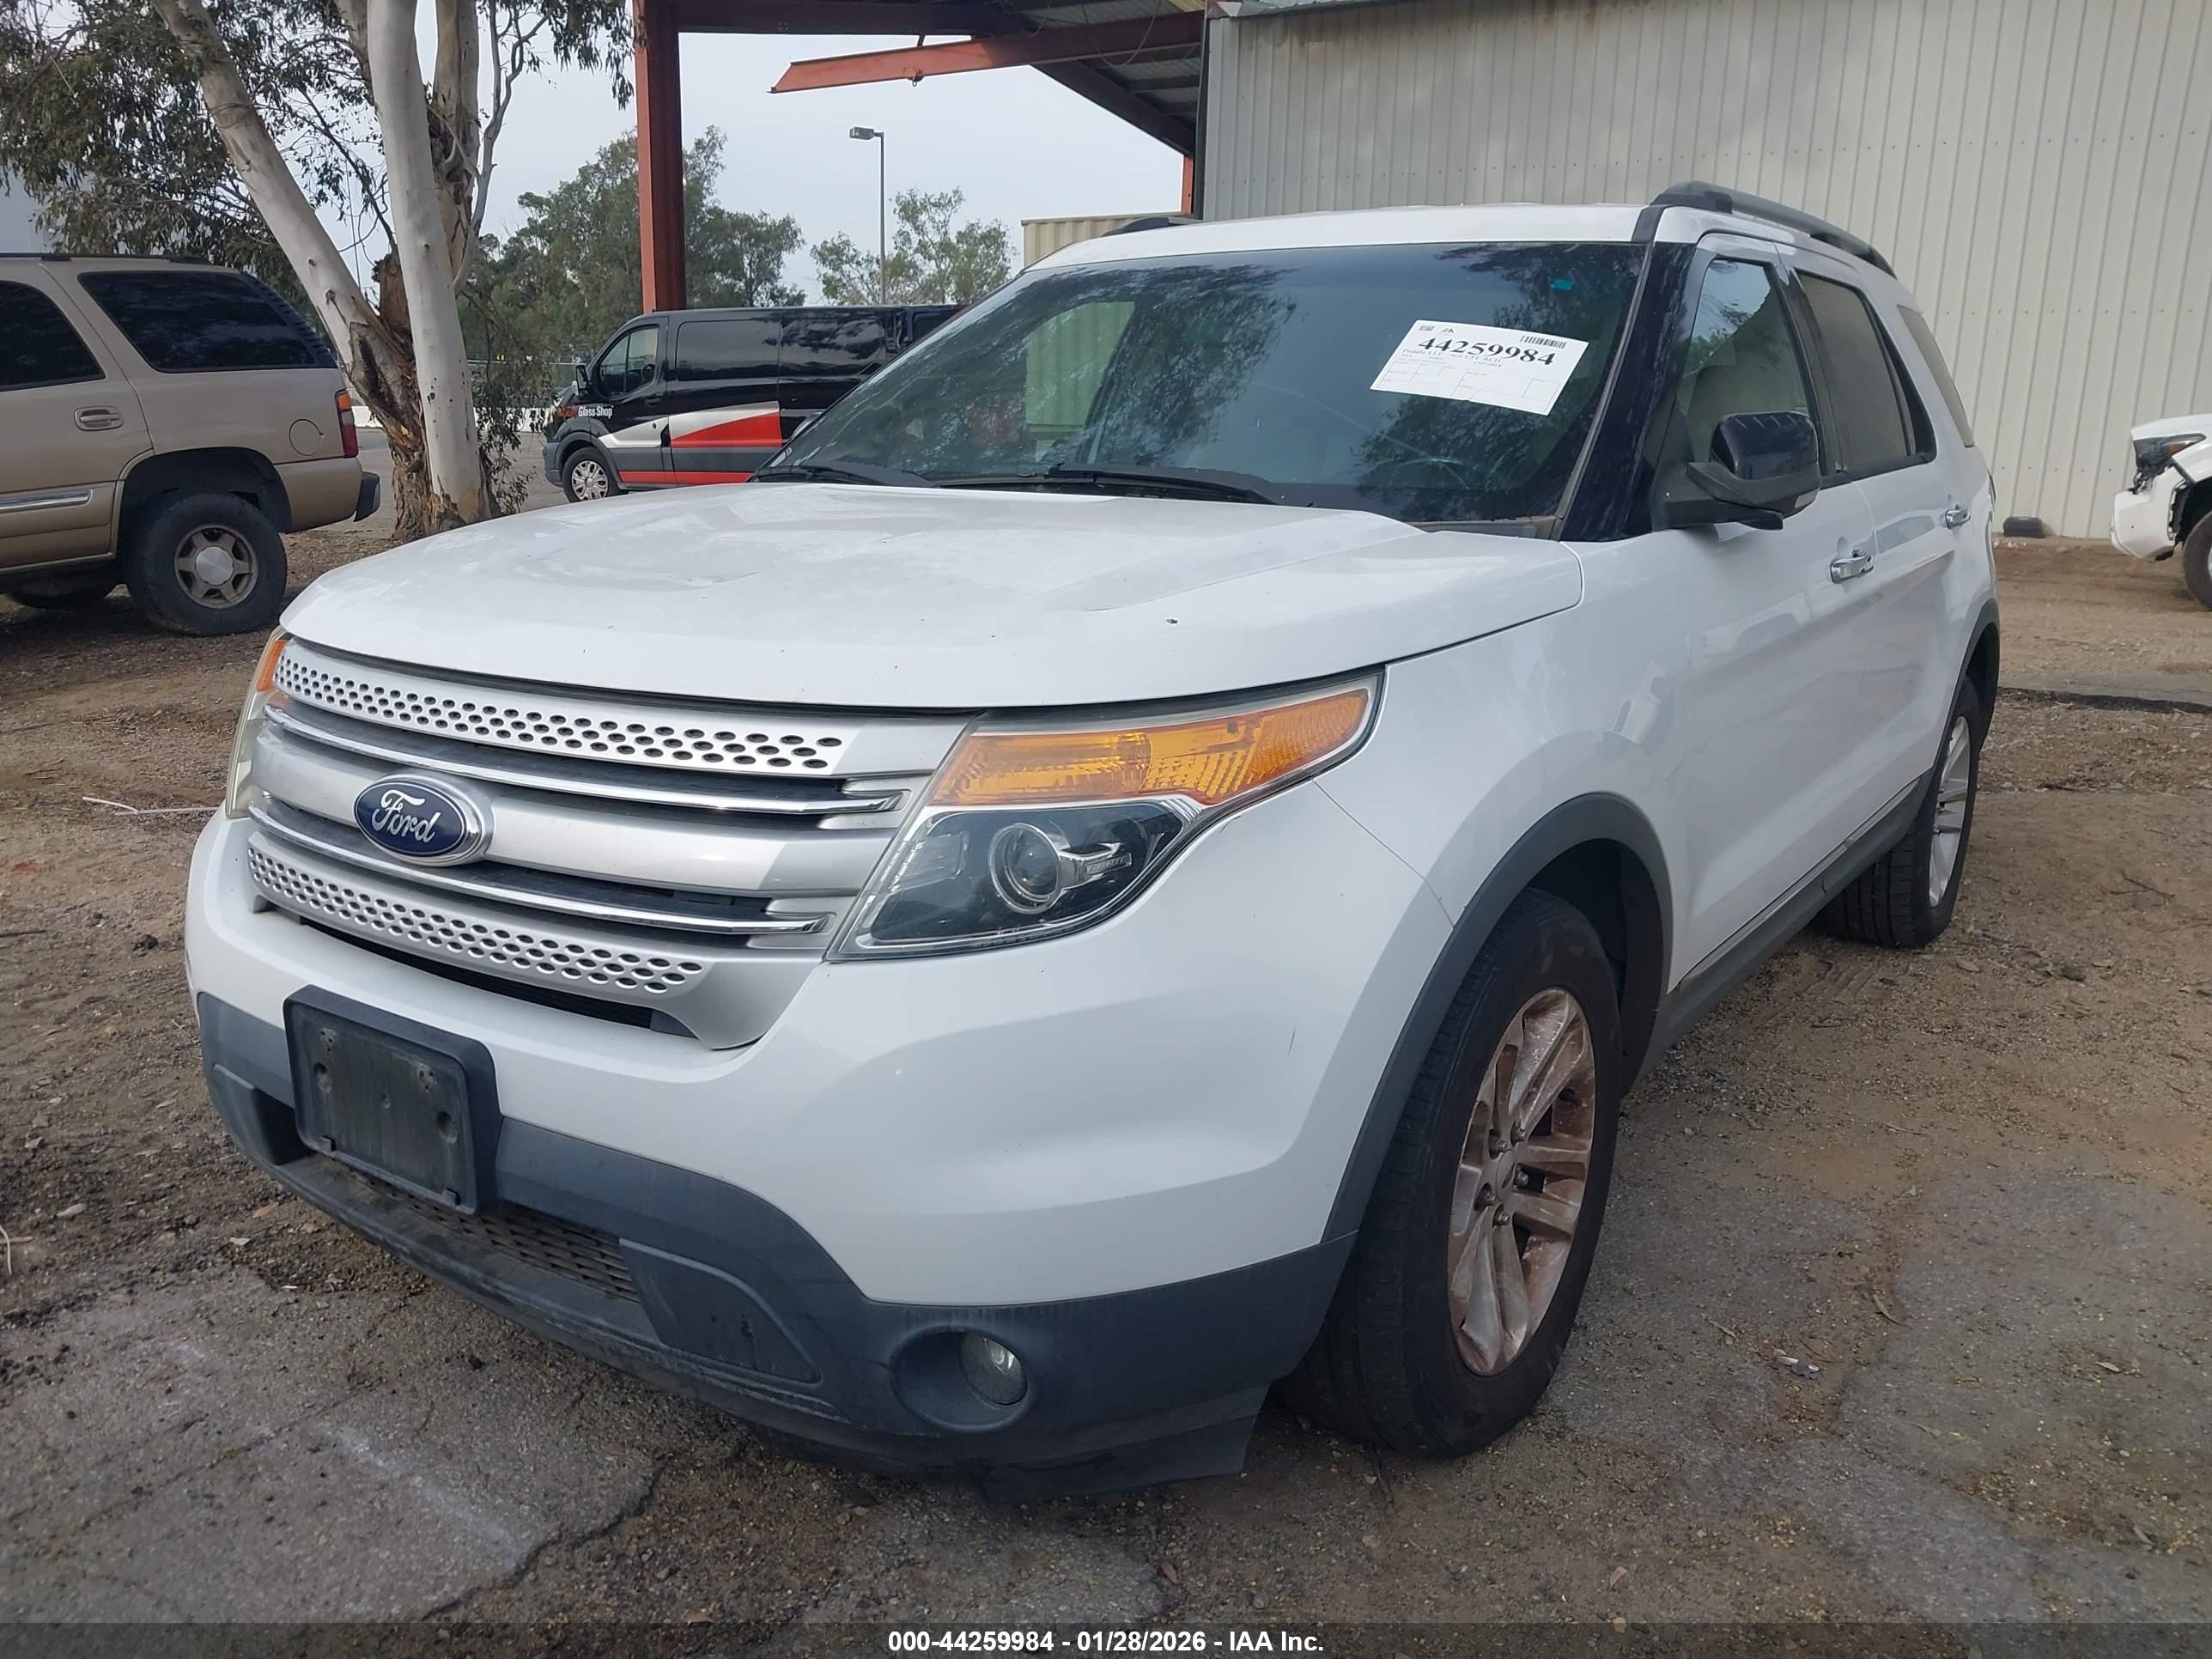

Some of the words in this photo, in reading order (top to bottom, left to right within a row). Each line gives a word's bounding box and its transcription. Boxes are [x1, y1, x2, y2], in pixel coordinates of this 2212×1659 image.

[1418, 337, 1556, 366] 44259984
[578, 405, 596, 417] Glass
[596, 405, 613, 420] Shop
[371, 789, 441, 843] Ford
